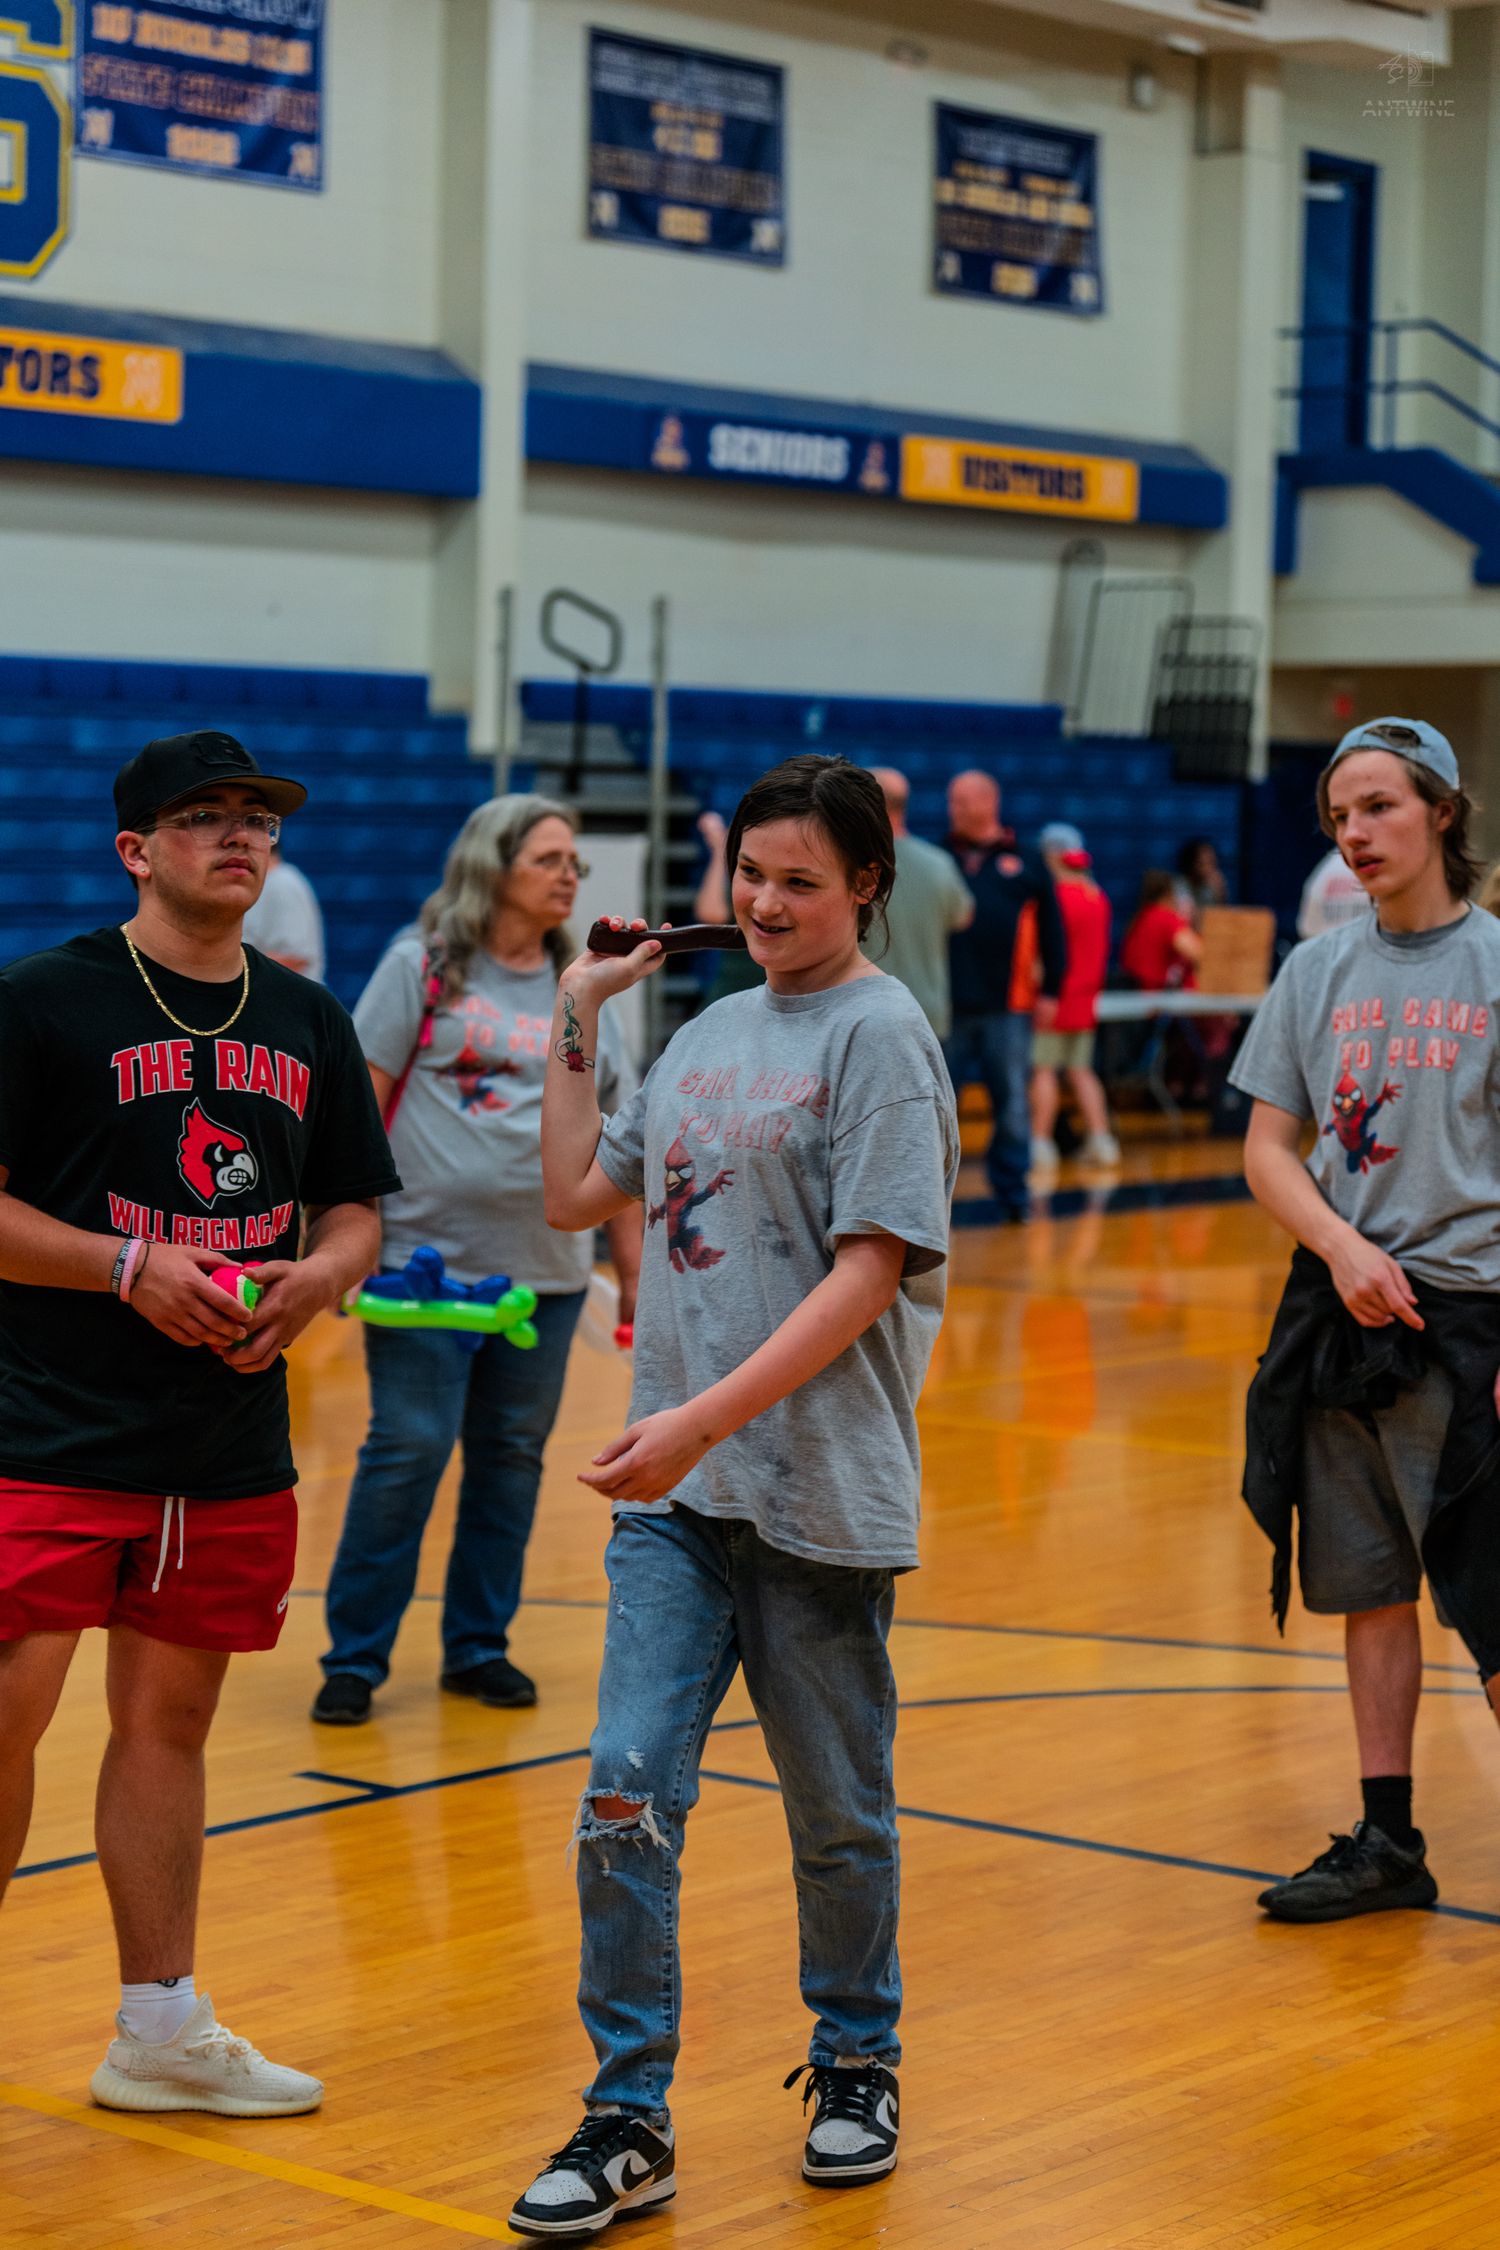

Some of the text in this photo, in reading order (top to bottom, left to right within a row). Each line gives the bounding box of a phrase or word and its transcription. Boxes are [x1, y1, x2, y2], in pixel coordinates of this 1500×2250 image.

[708, 423, 850, 482] SENIORS
[110, 1038, 310, 1122] THE RAIN
[1341, 1037, 1460, 1071] TO PLAY
[108, 1191, 169, 1243] WILL
[172, 1213, 241, 1251] REIGN
[112, 1260, 124, 1279] JUST
